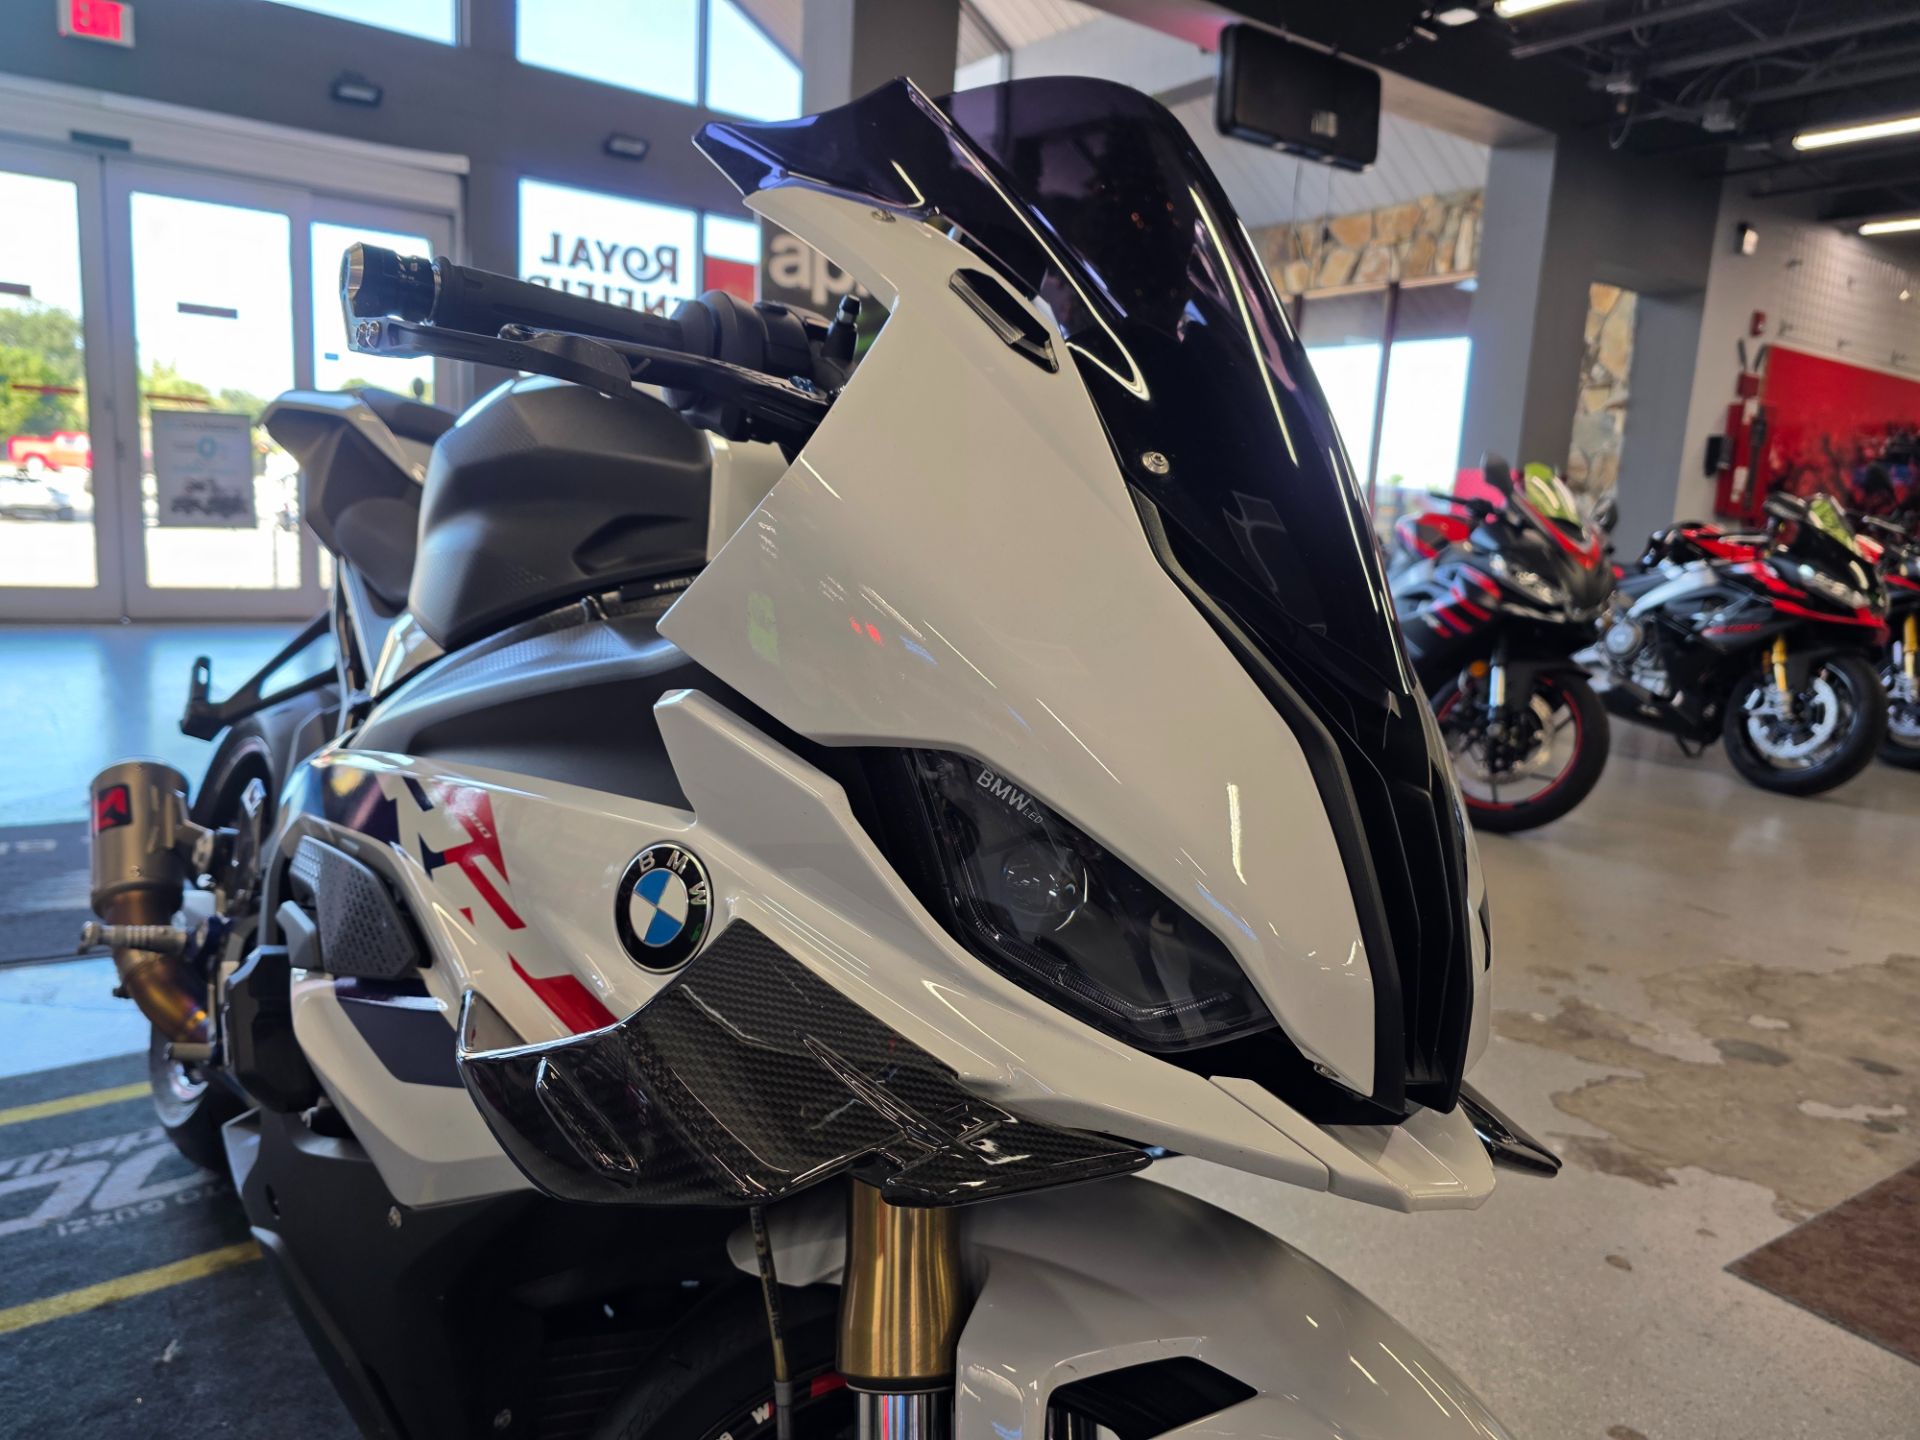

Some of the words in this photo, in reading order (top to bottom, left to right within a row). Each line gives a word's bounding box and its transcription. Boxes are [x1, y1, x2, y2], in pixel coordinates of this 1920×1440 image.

[768, 232, 870, 305] ap
[976, 768, 1031, 812] BMW
[1022, 807, 1044, 824] LED
[638, 848, 708, 906] BMW
